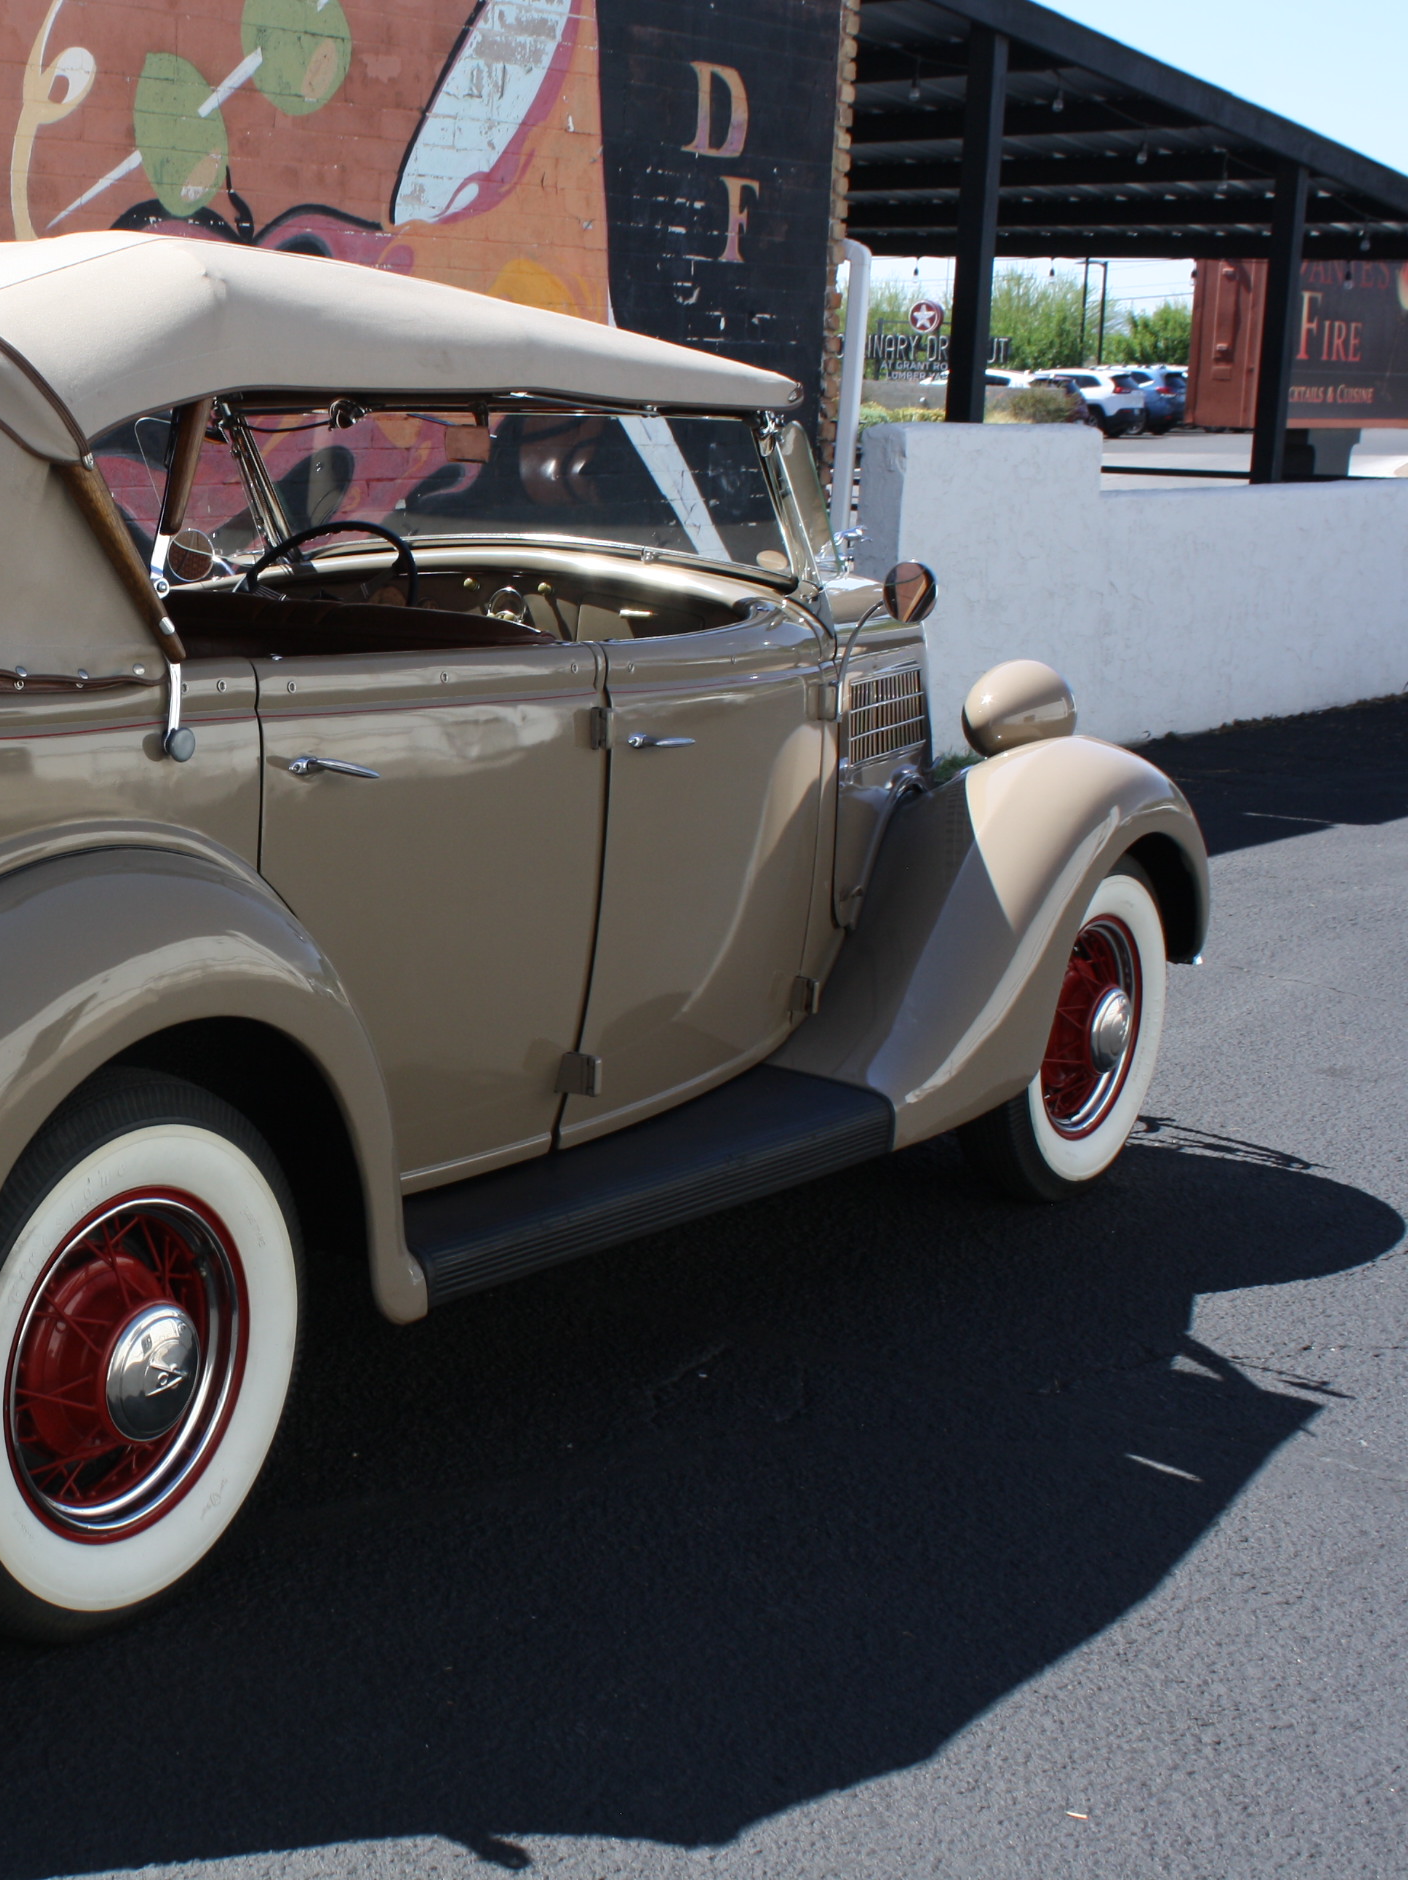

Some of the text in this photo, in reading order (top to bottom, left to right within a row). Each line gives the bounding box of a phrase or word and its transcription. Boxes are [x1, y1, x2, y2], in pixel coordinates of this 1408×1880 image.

[680, 60, 750, 158] D
[717, 175, 760, 264] F
[881, 361, 892, 370] AT
[896, 361, 930, 371] GRANT
